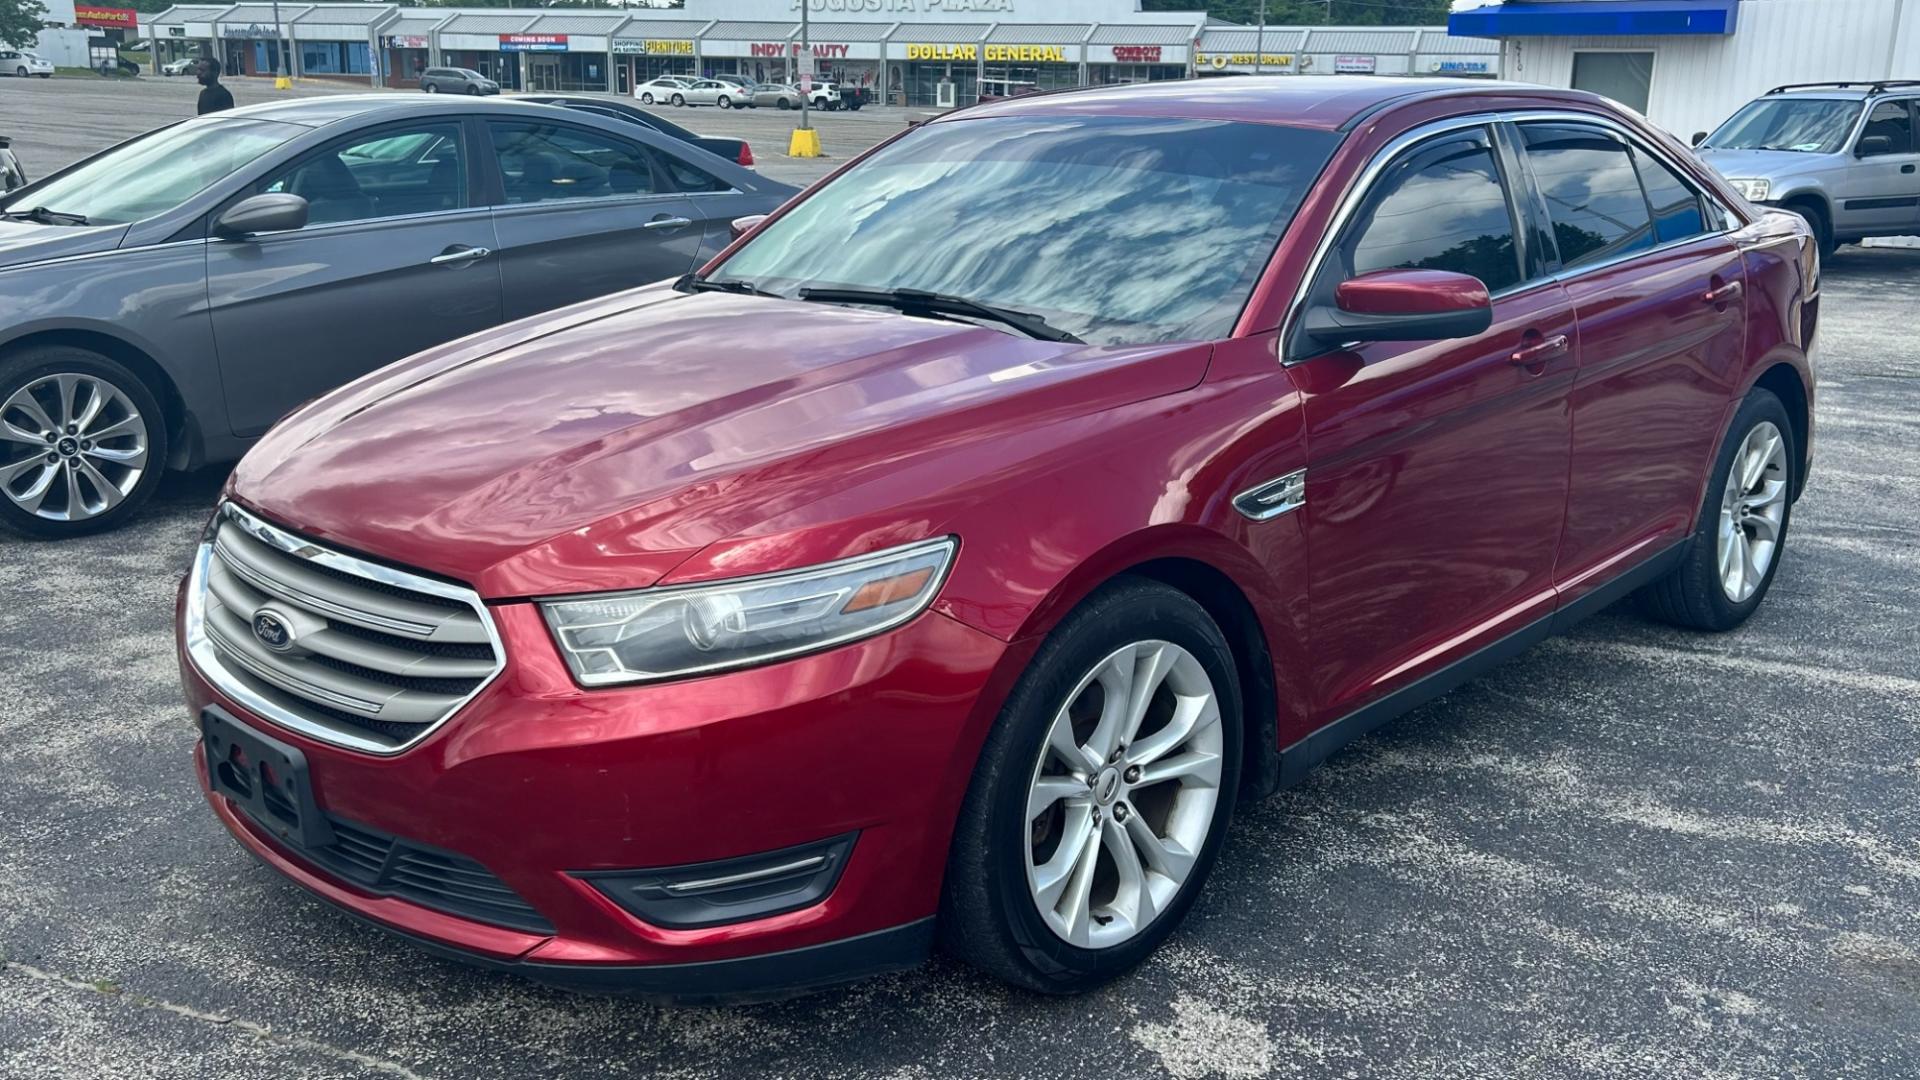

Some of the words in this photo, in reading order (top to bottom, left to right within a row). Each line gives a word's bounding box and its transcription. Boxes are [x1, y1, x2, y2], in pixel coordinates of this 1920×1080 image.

[789, 0, 915, 12] AUGUSTA
[924, 0, 1014, 12] PLAZA
[646, 40, 693, 54] FURNITURE
[750, 43, 785, 57] INDY
[792, 43, 850, 57] BAUTY
[907, 44, 977, 60] DOLLAR
[984, 44, 1066, 61] GENERAL
[1112, 46, 1162, 56] COWBOYS
[1196, 53, 1206, 64] EL
[1231, 54, 1292, 65] RESTURANT
[257, 617, 282, 642] Ford
